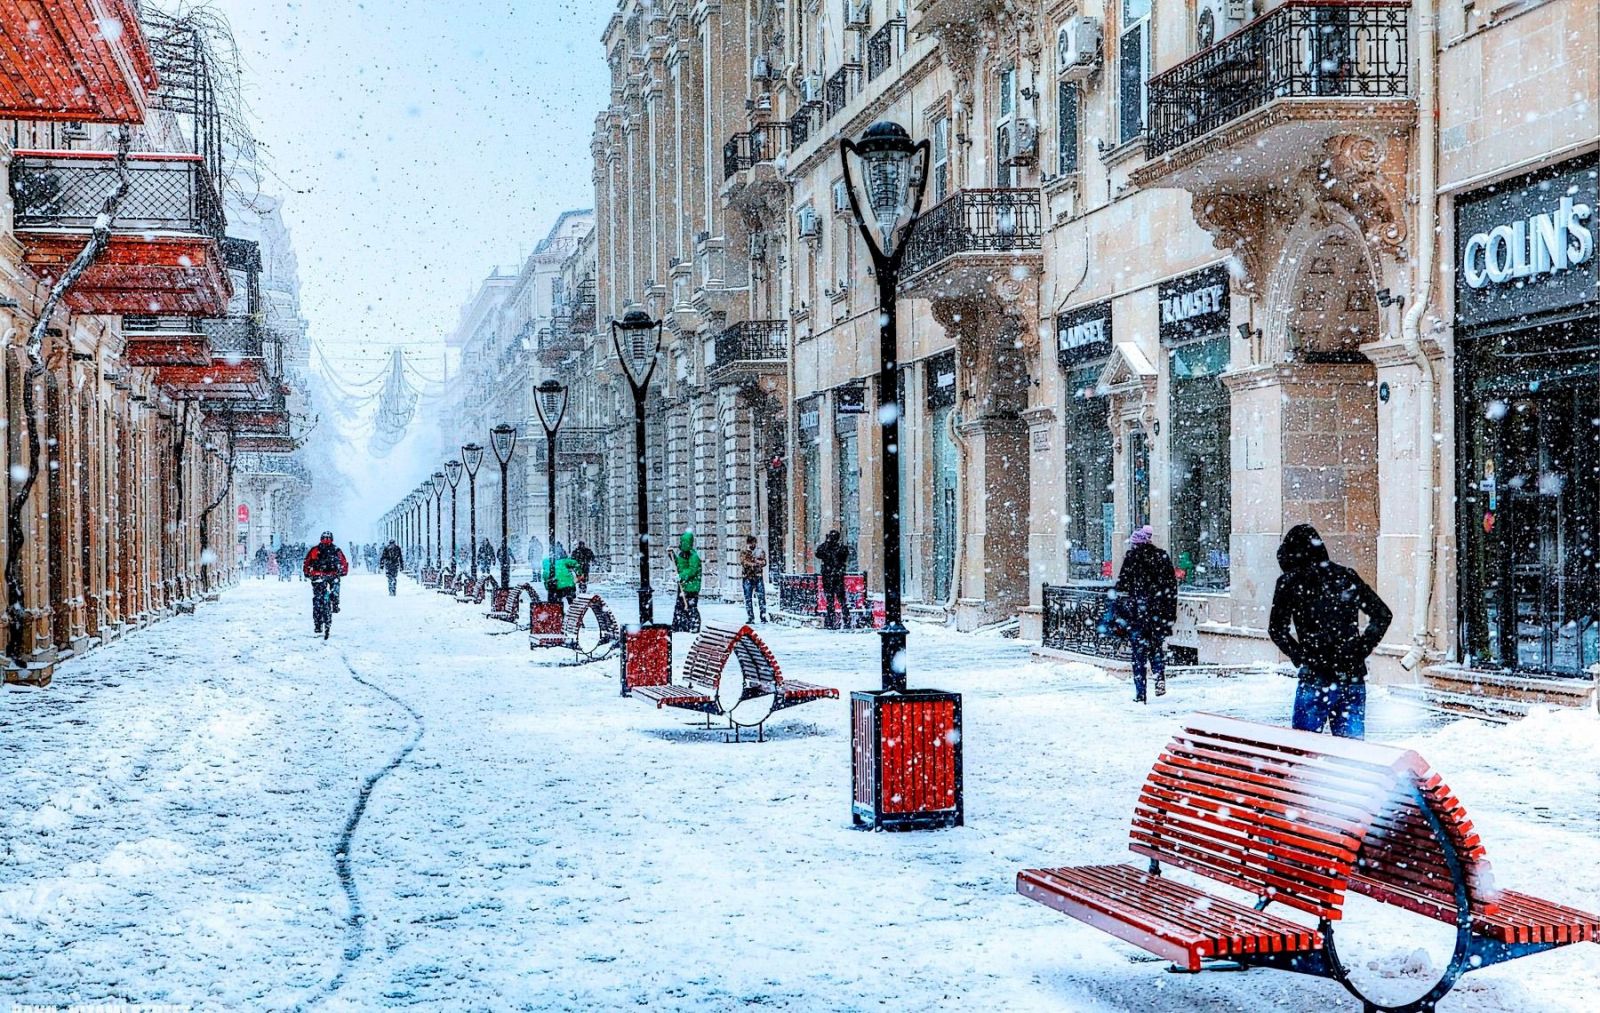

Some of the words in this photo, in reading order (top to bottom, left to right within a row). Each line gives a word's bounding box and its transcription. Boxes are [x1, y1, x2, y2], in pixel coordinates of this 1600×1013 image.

[1464, 196, 1593, 289] COLIN'S
[1162, 285, 1223, 323] RAMSEY
[1059, 317, 1105, 350] RAMSEY
